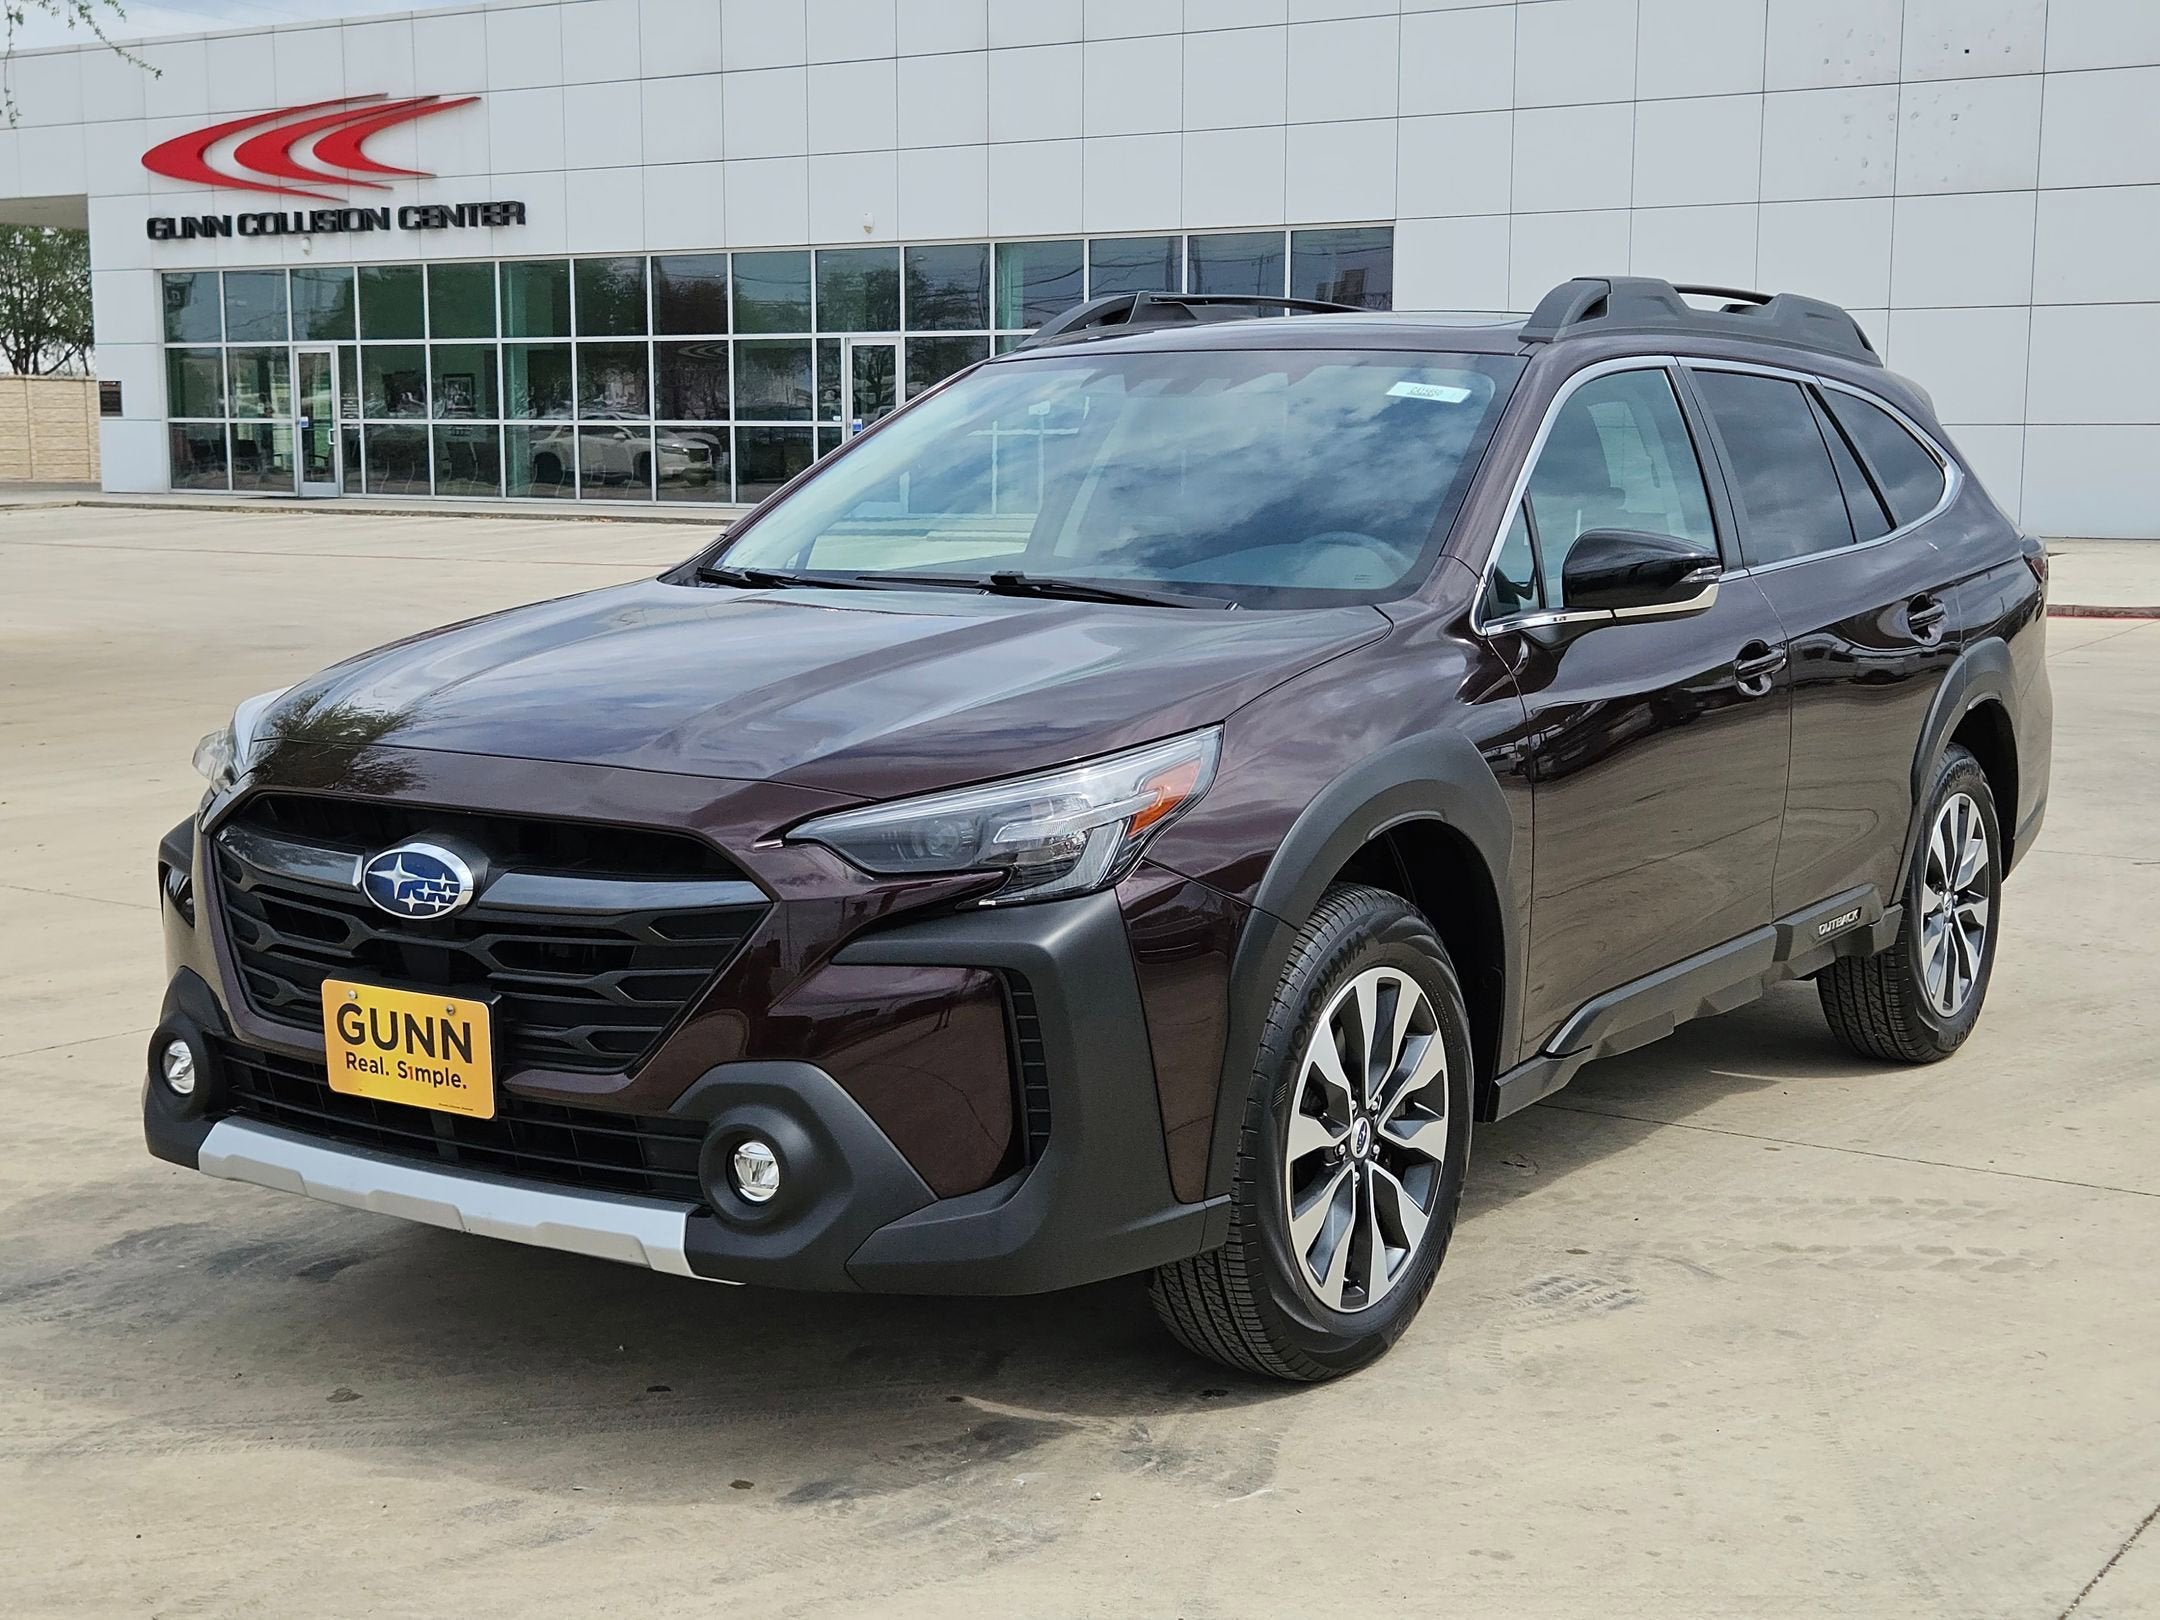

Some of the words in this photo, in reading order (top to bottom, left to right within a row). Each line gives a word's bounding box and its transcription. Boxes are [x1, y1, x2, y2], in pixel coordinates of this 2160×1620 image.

[146, 215, 232, 240] GUNN
[237, 207, 390, 236] COLLISION
[398, 201, 526, 230] CENTER
[1818, 908, 1860, 935] OUTBACK
[1283, 930, 1368, 1063] YOKOHAMA
[336, 1003, 473, 1064] GUNN
[345, 1051, 390, 1076] Real.
